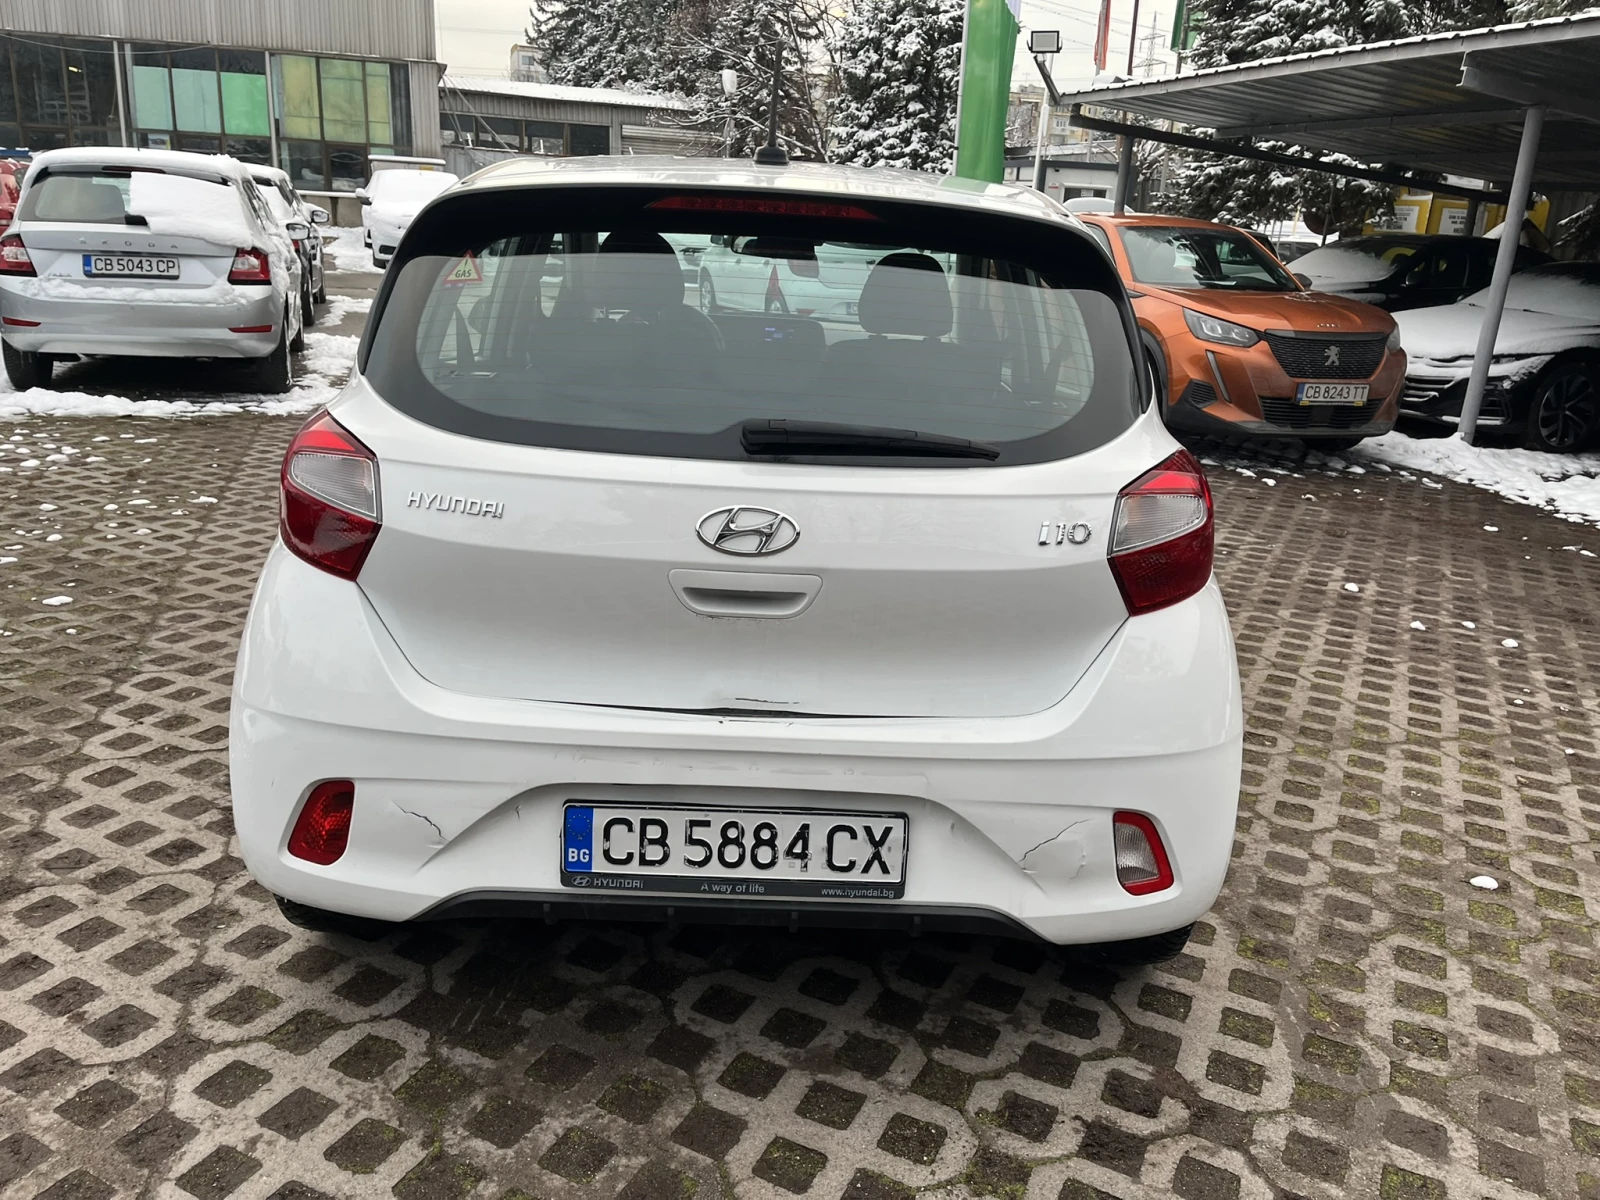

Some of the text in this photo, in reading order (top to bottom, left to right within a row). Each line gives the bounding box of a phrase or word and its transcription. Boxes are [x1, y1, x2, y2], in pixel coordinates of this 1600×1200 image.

[94, 258, 114, 271] CB
[117, 258, 153, 273] 5043
[156, 260, 176, 273] CP
[455, 270, 472, 278] GAS
[1305, 386, 1367, 400] CB 8243 TT
[407, 491, 504, 519] HYUNDAI
[1038, 521, 1092, 546] i10
[602, 817, 894, 875] CB 5884 CX
[568, 848, 590, 862] BG
[593, 877, 644, 889] HYUNDAI
[700, 882, 765, 894] A way of life
[821, 887, 895, 899] www.hyundai.bg
